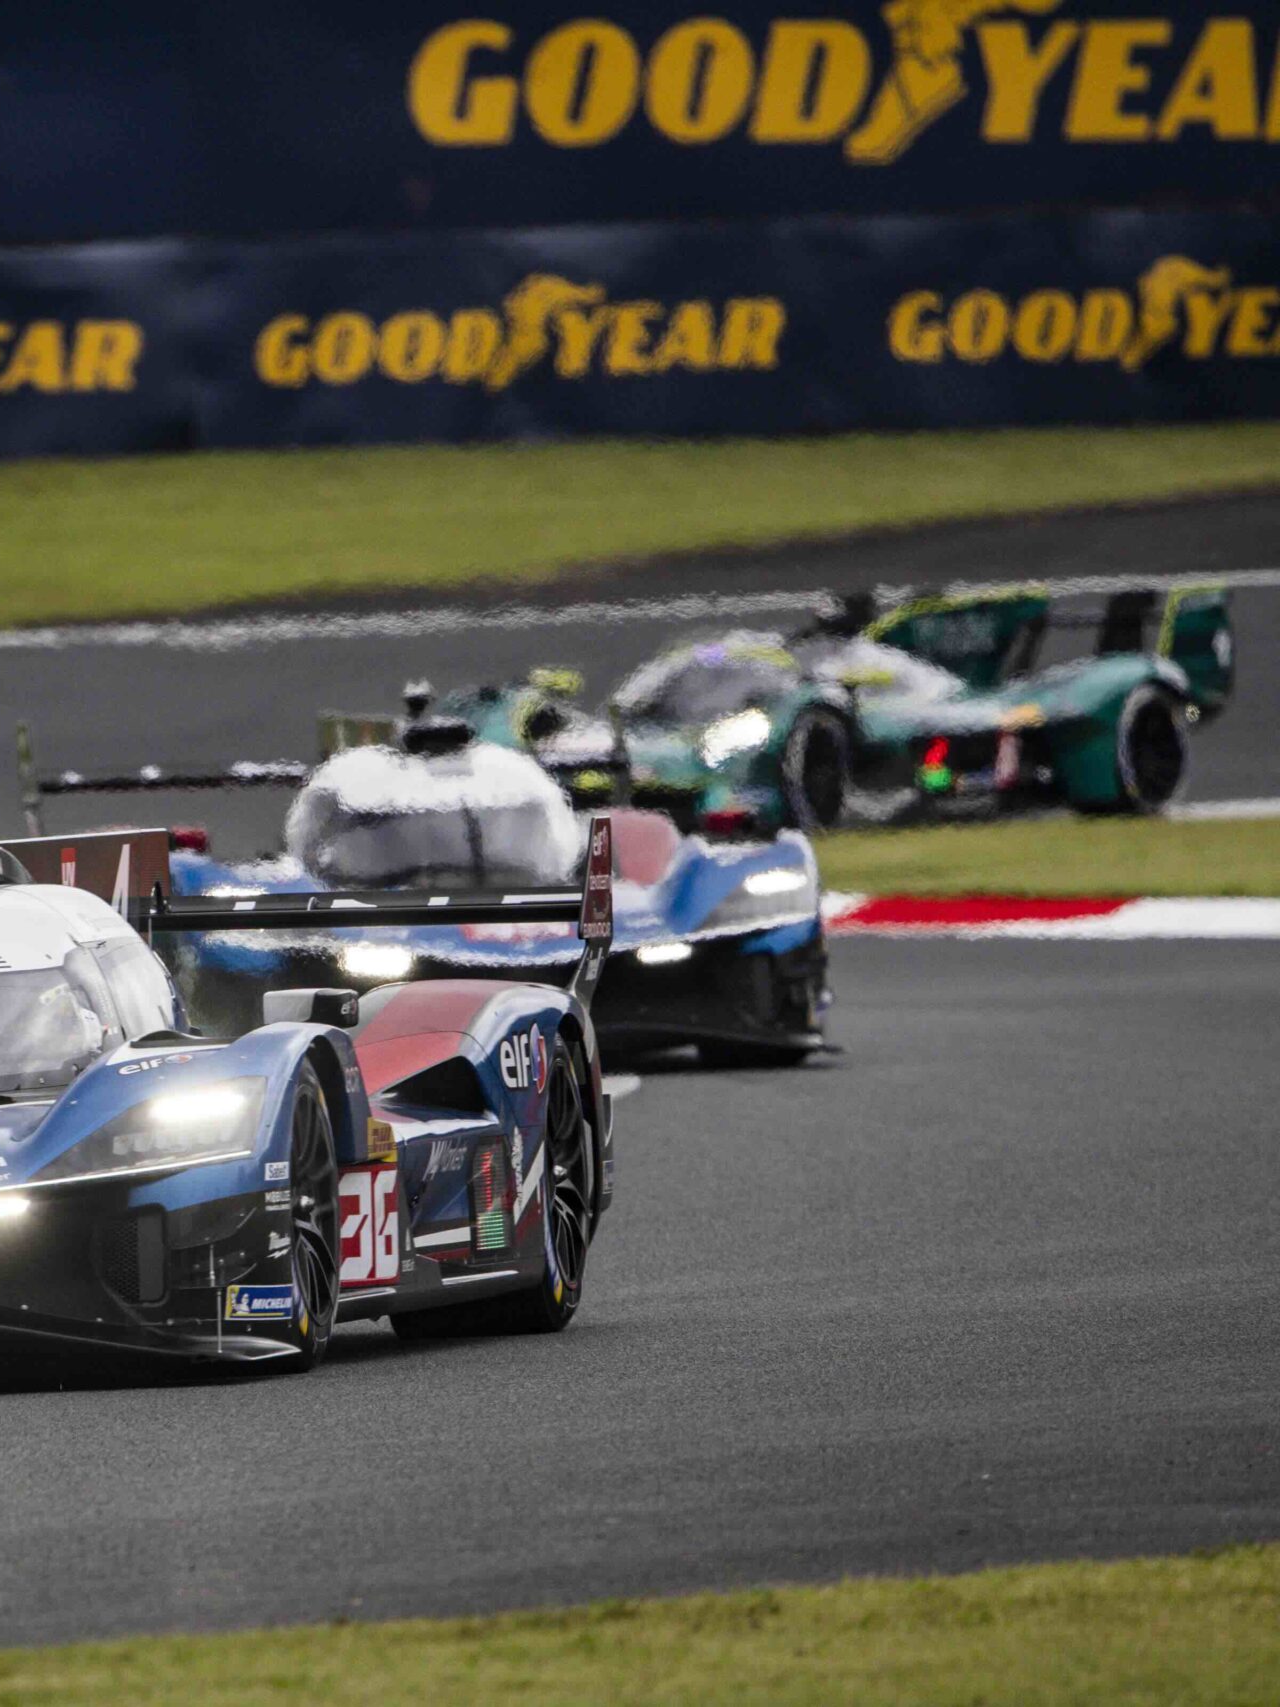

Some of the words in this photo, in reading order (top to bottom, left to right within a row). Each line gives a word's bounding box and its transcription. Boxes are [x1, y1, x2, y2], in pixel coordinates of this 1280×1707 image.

[408, 17, 1280, 147] GOODYEA
[257, 297, 785, 387] GOODYEAR
[888, 287, 1280, 363] GOODYE
[118, 1058, 163, 1075] elf
[500, 1034, 530, 1088] elf
[338, 1169, 398, 1282] 36
